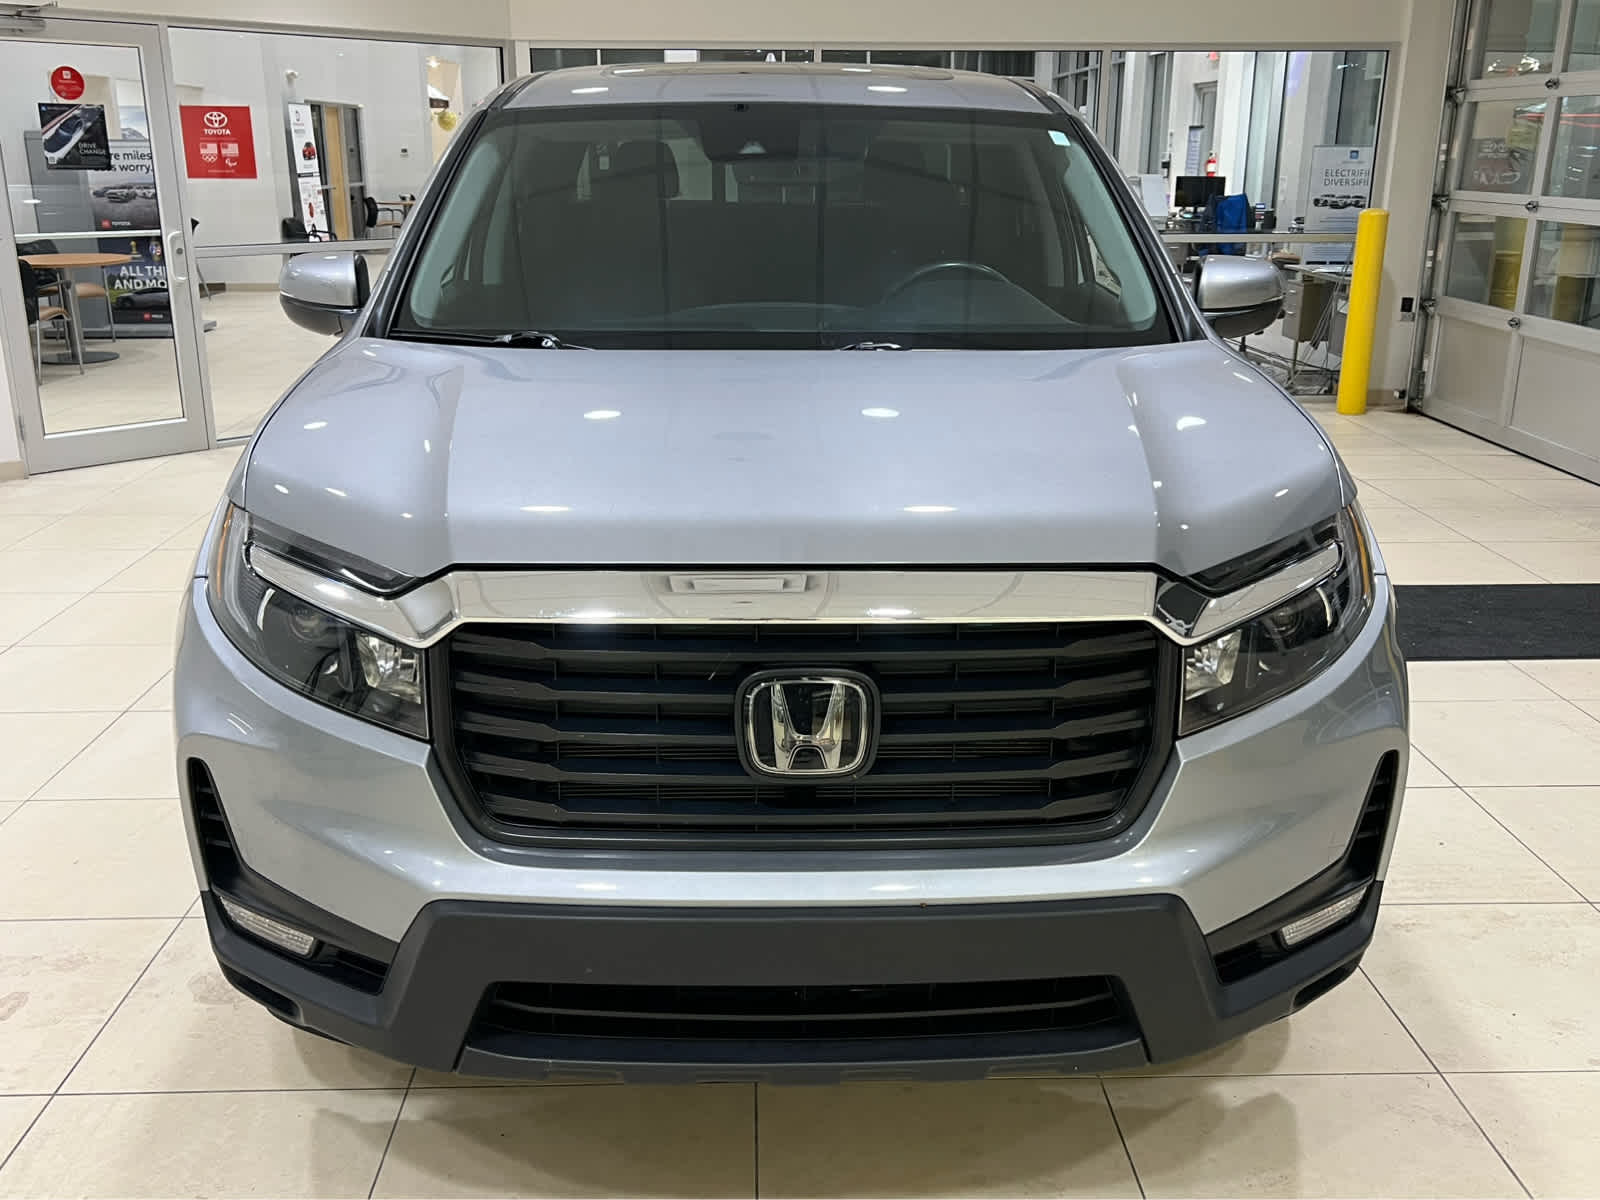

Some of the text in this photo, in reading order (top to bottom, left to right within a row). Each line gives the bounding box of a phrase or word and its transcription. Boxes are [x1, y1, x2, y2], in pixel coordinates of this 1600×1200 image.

[123, 150, 153, 160] miles
[120, 265, 166, 277] ALL THI
[114, 279, 168, 290] AND MO
